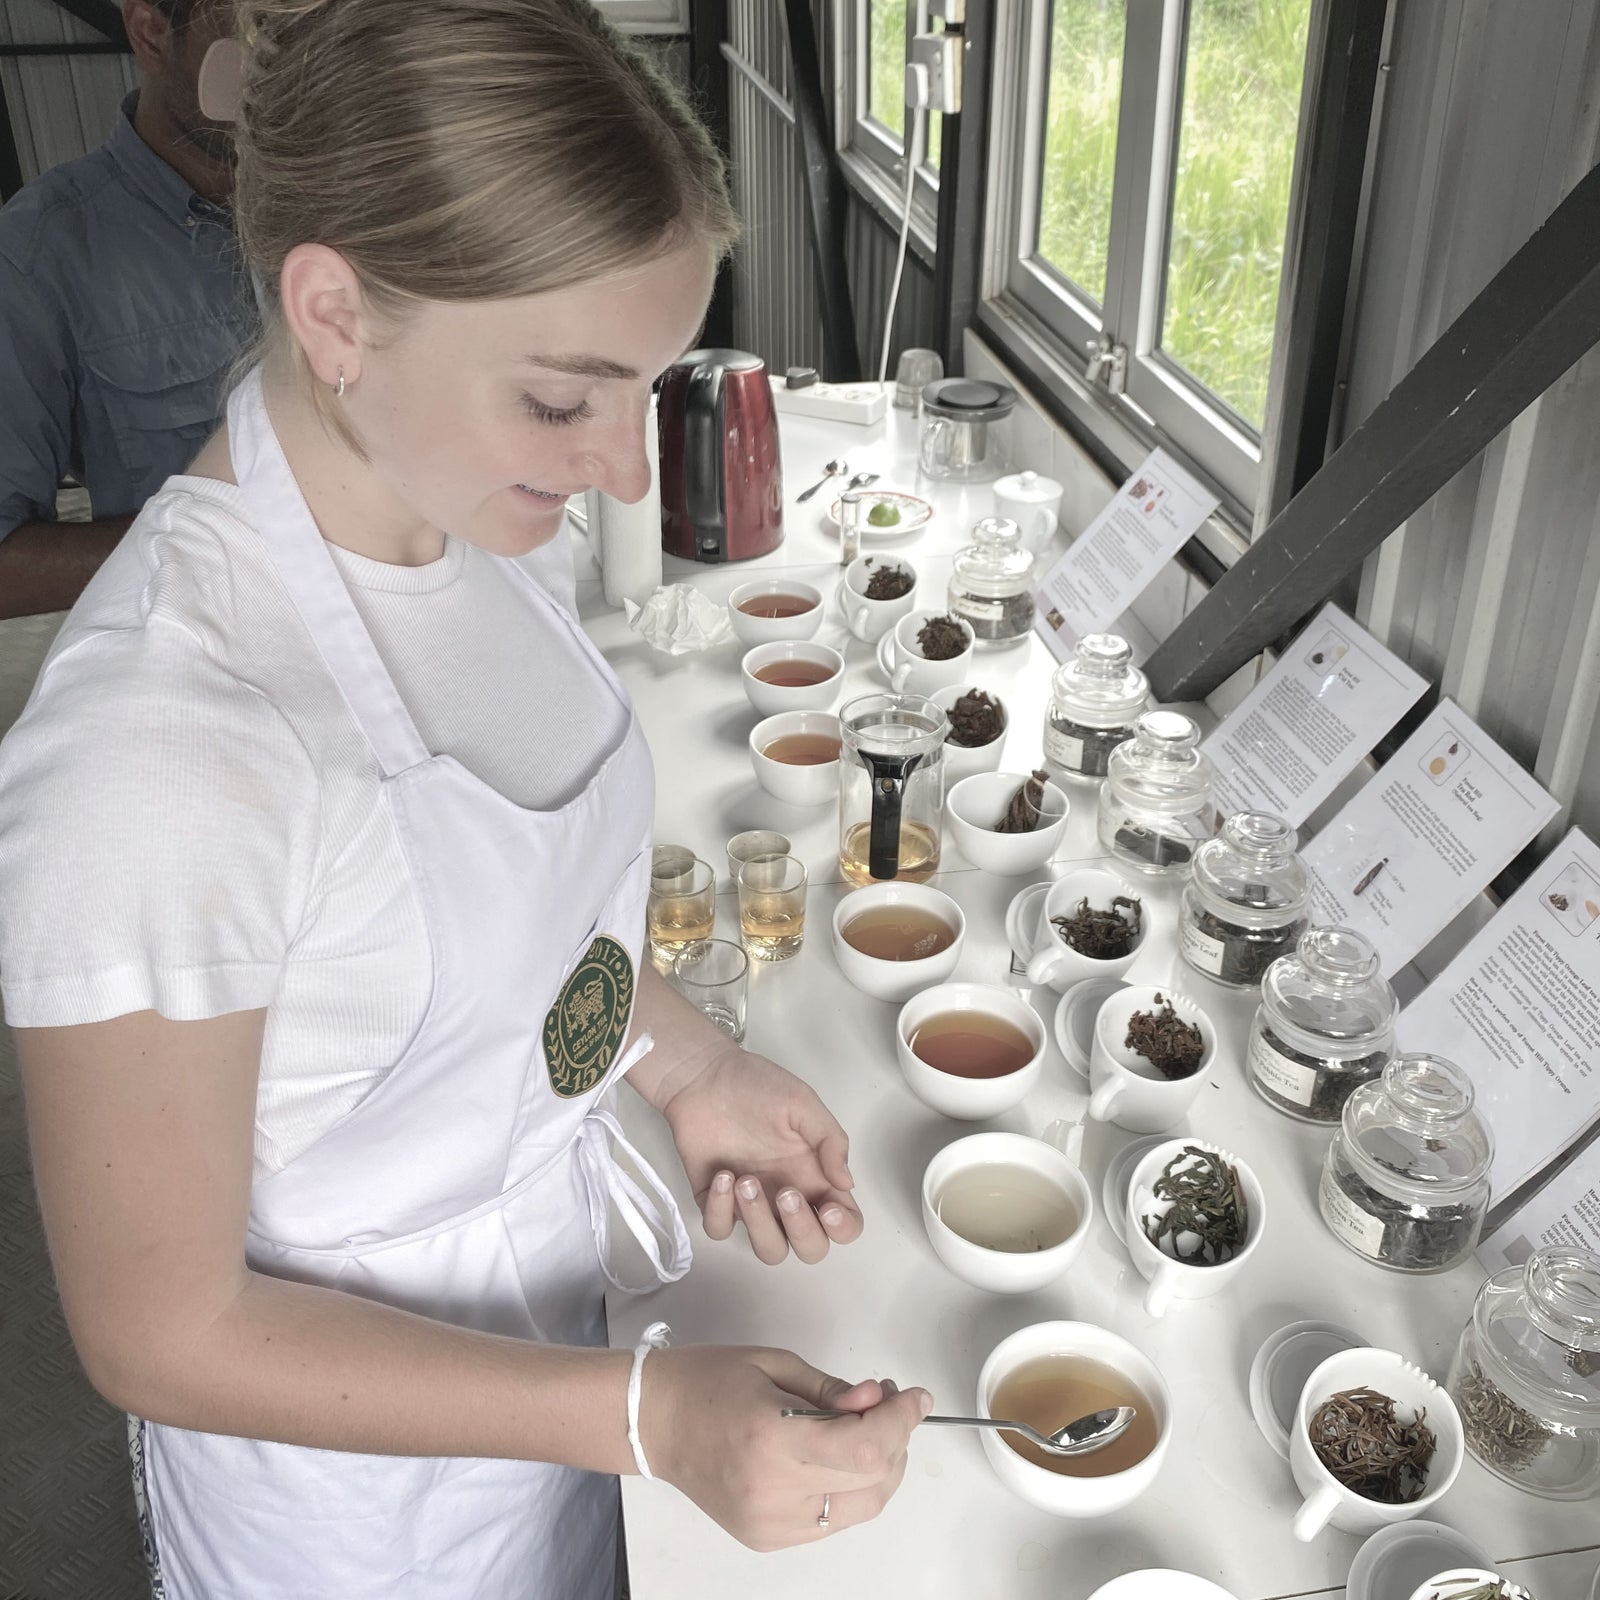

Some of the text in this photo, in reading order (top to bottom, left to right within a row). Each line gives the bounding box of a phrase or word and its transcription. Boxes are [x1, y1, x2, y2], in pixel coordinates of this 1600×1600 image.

[587, 940, 622, 967] 2017
[1552, 951, 1565, 964] Tippy
[1564, 964, 1579, 979] Orange
[1579, 979, 1590, 990] Leaf
[1589, 989, 1597, 998] tea
[572, 1024, 597, 1053] CEYLON
[571, 1044, 612, 1094] 150
[1542, 1061, 1555, 1076] Tippy
[1554, 1076, 1571, 1094] Orange
[1283, 1078, 1301, 1092] Tea
[1348, 1219, 1365, 1235] Tea
[1562, 1214, 1570, 1224] For
[1570, 1223, 1580, 1236] cold
